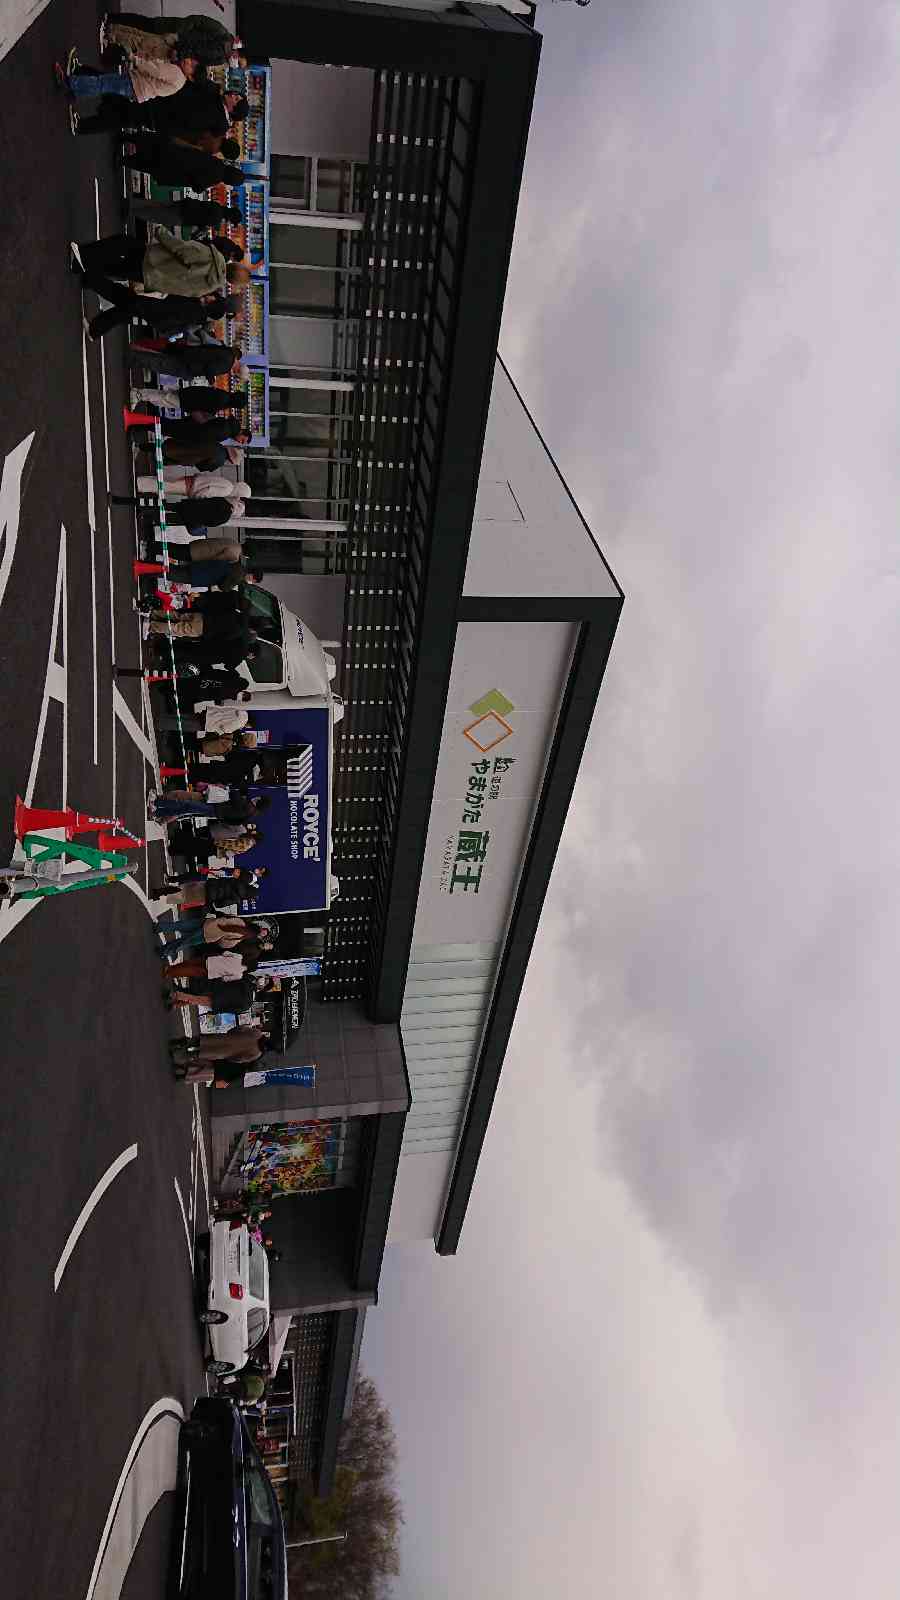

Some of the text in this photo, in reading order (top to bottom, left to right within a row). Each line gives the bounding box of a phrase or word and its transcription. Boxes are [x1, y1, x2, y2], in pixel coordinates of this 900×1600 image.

[289, 800, 297, 859] HOCOLATE SHOP
[302, 794, 320, 862] ROYCE'
[449, 758, 491, 894] やまがた 蔵王
